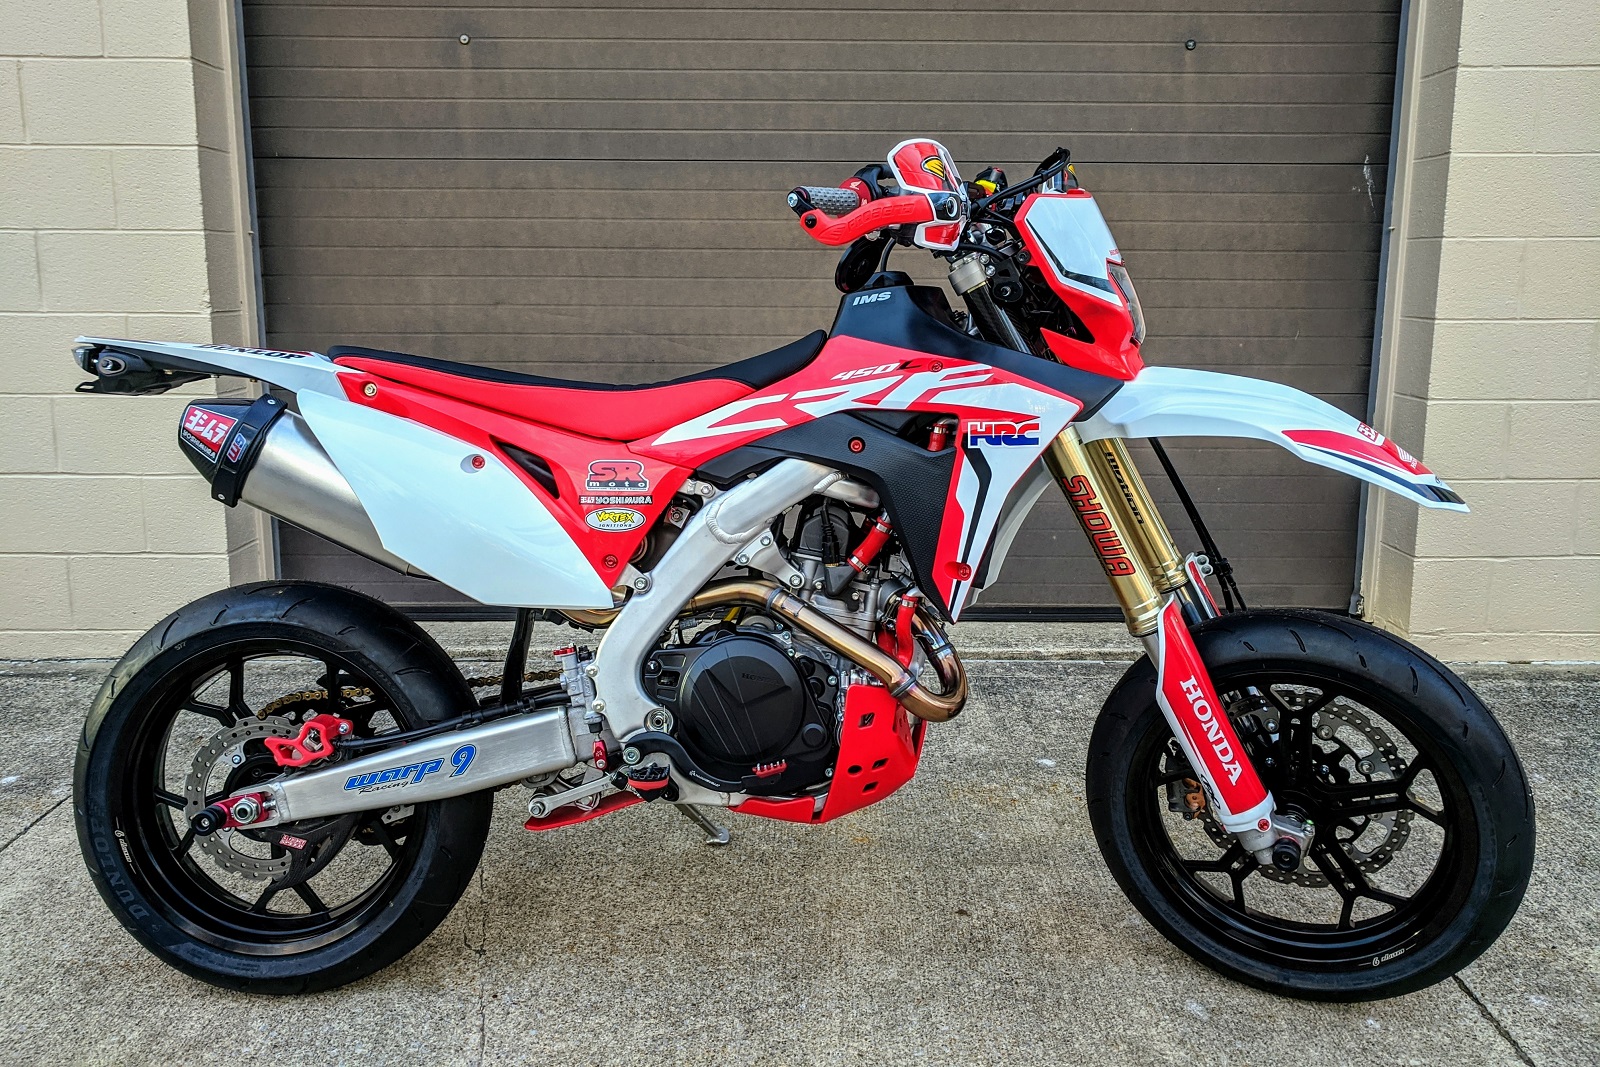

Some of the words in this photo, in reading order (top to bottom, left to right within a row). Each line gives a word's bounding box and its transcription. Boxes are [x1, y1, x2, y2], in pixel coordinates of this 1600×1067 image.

[852, 291, 892, 306] IMS
[650, 363, 993, 446] CRF
[184, 410, 229, 444] ヨシムラ
[967, 421, 1041, 449] HRC
[587, 460, 645, 482] SR
[595, 496, 652, 505] YOSHIMURA
[1060, 474, 1136, 577] SHOWA
[1179, 674, 1243, 787] HONDA
[449, 743, 477, 778] 9
[358, 781, 409, 795] Racing
